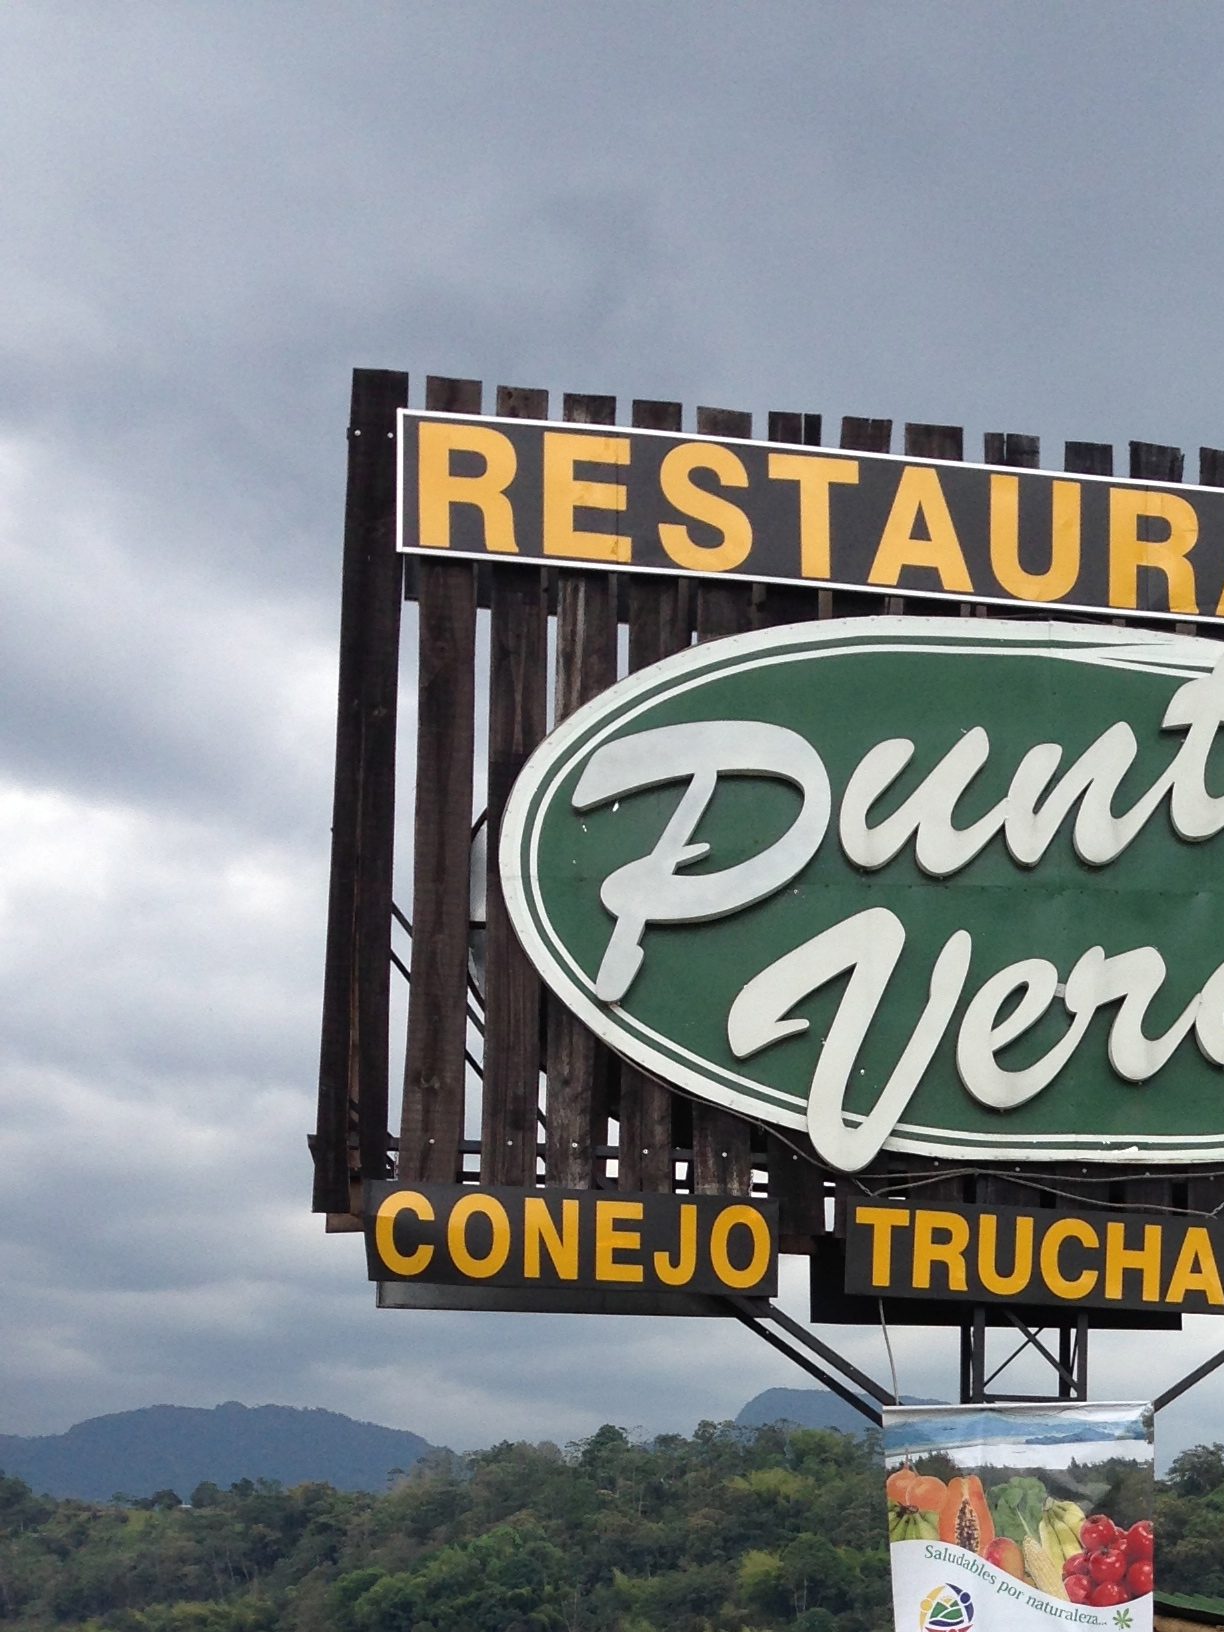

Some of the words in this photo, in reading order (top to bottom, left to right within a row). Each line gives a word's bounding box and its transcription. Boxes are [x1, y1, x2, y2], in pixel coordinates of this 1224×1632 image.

[374, 1190, 772, 1291] CONEJO
[924, 1544, 998, 1585] Saludables
[997, 1580, 1025, 1600] por
